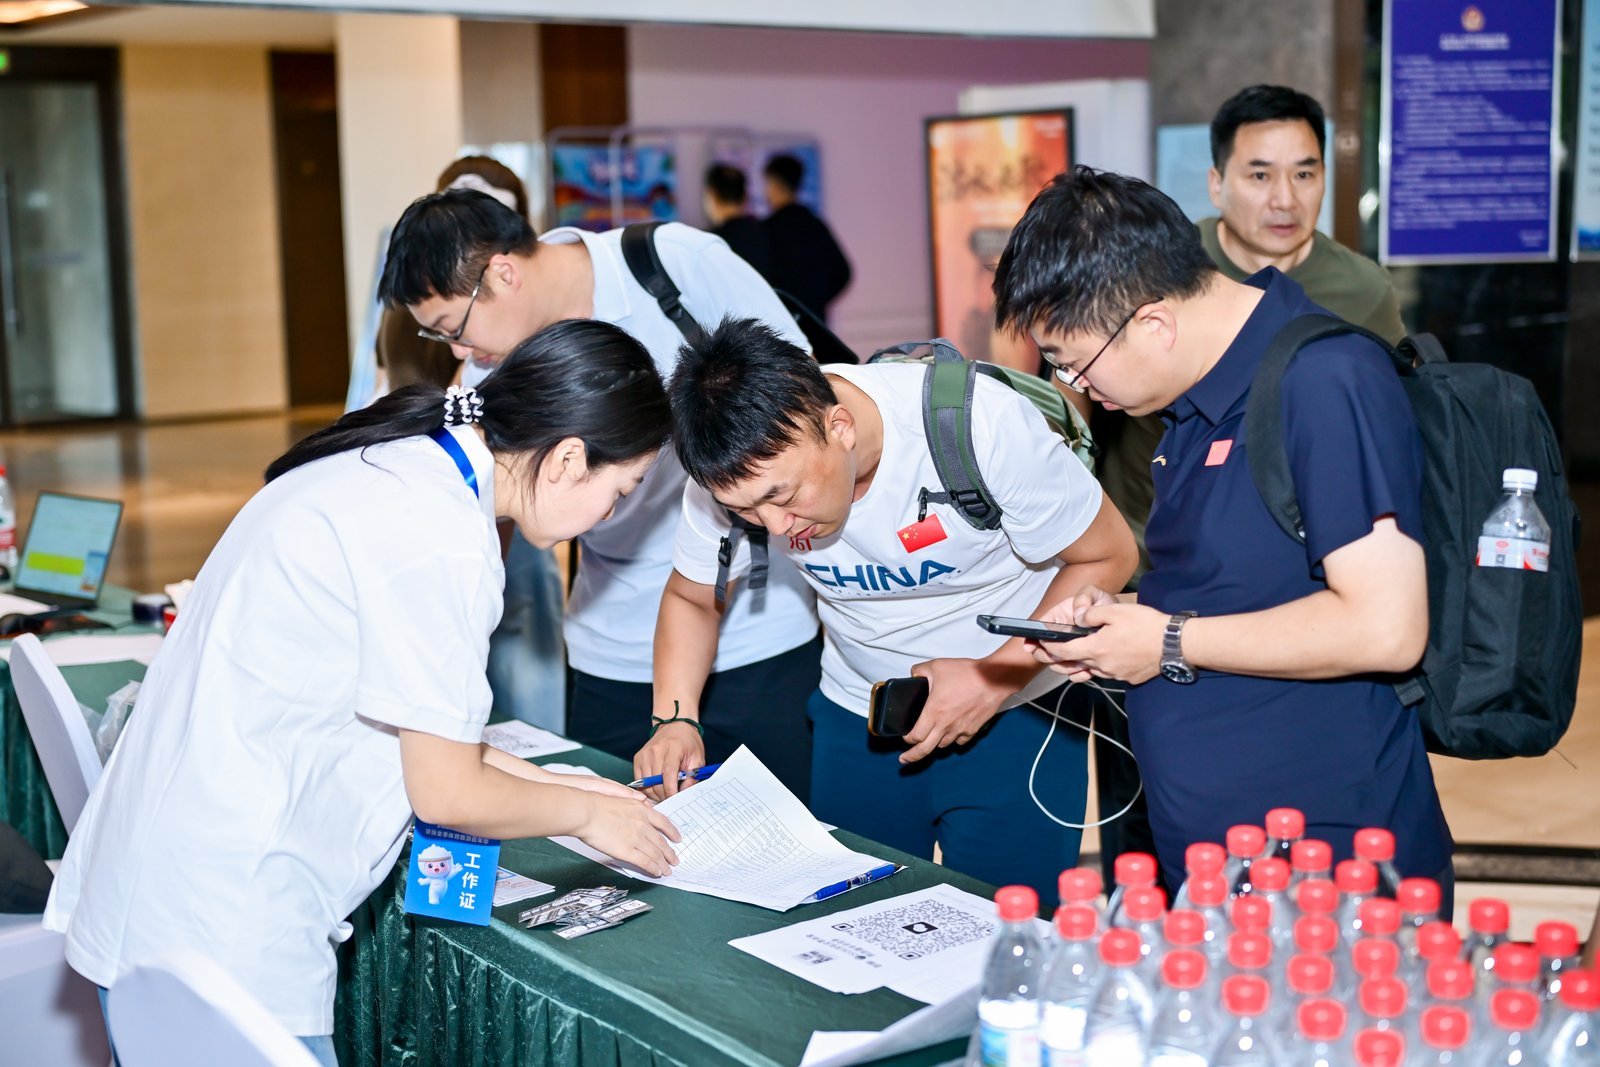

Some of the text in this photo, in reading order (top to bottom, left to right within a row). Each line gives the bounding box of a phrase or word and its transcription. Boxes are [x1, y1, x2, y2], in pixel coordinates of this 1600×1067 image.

[805, 559, 957, 591] CHINA
[459, 852, 480, 909] 工作证
